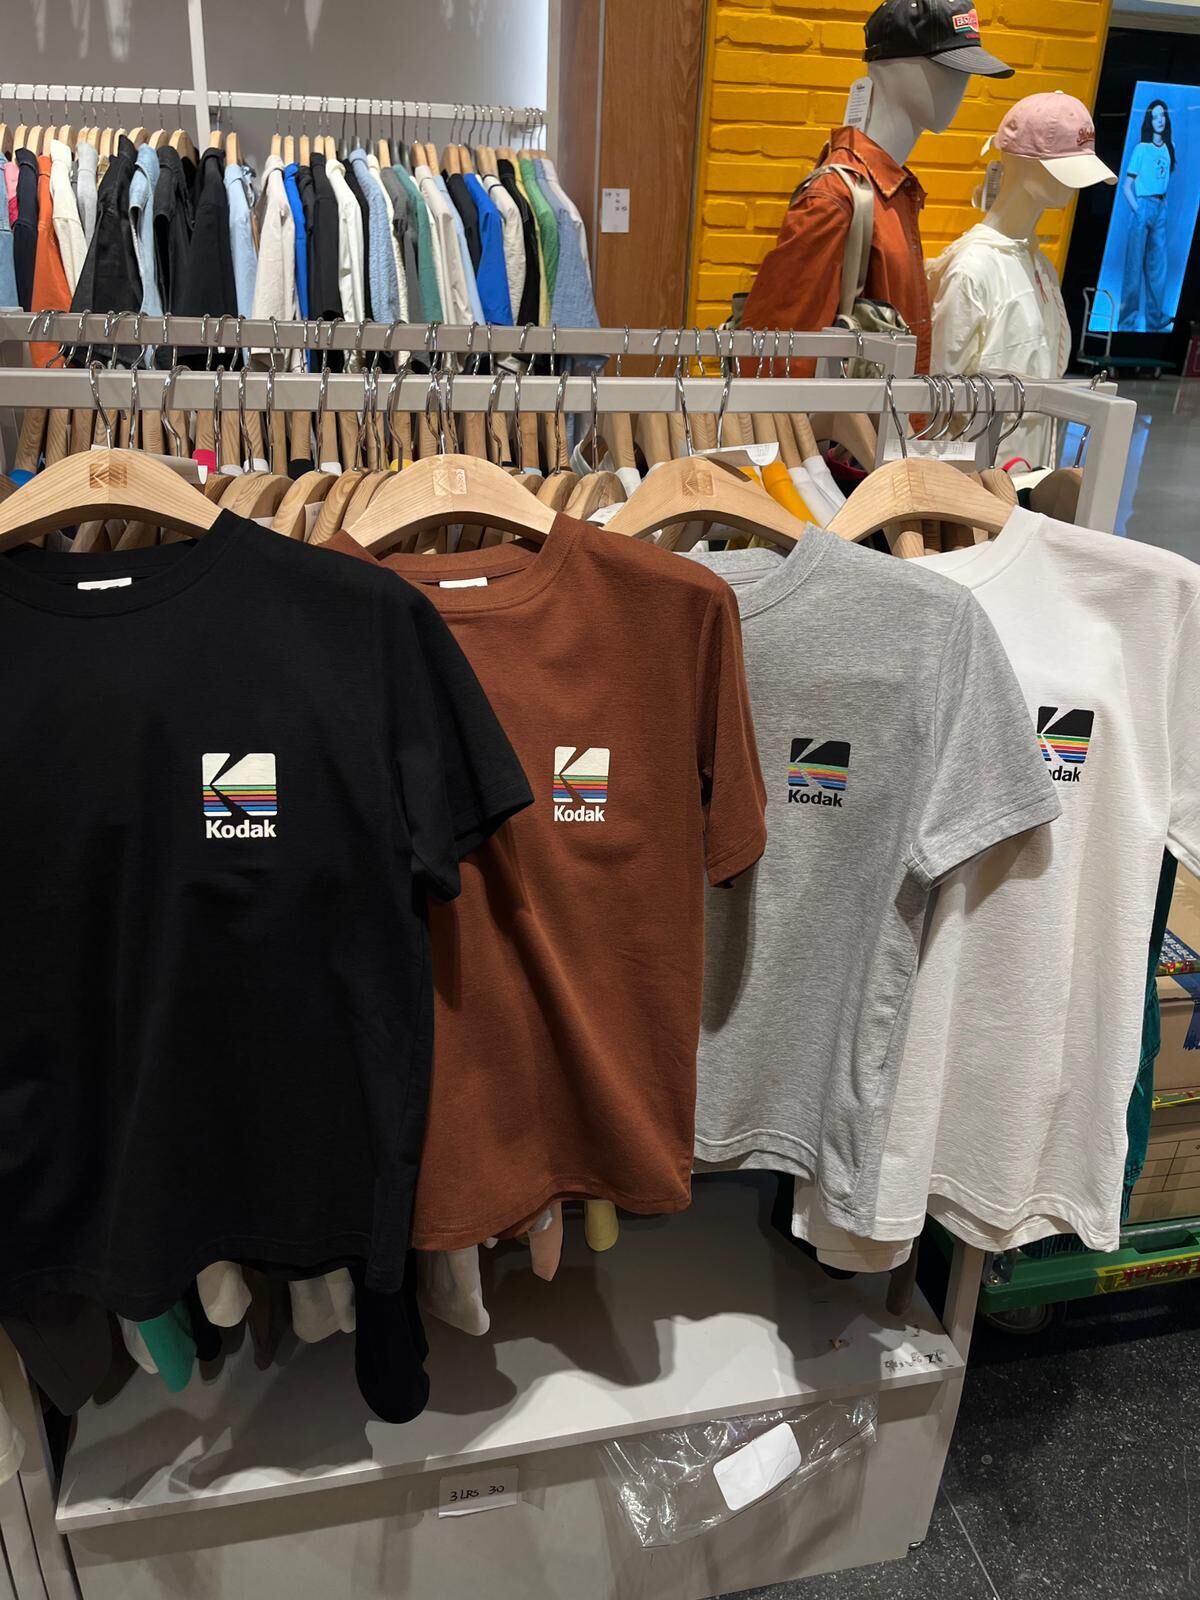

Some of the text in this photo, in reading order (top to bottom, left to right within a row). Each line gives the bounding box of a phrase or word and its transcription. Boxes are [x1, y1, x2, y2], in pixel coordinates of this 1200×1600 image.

[787, 789, 843, 808] Kodak
[553, 804, 606, 822] Kodak
[205, 819, 277, 839] Kodak
[488, 1485, 505, 1495] 30
